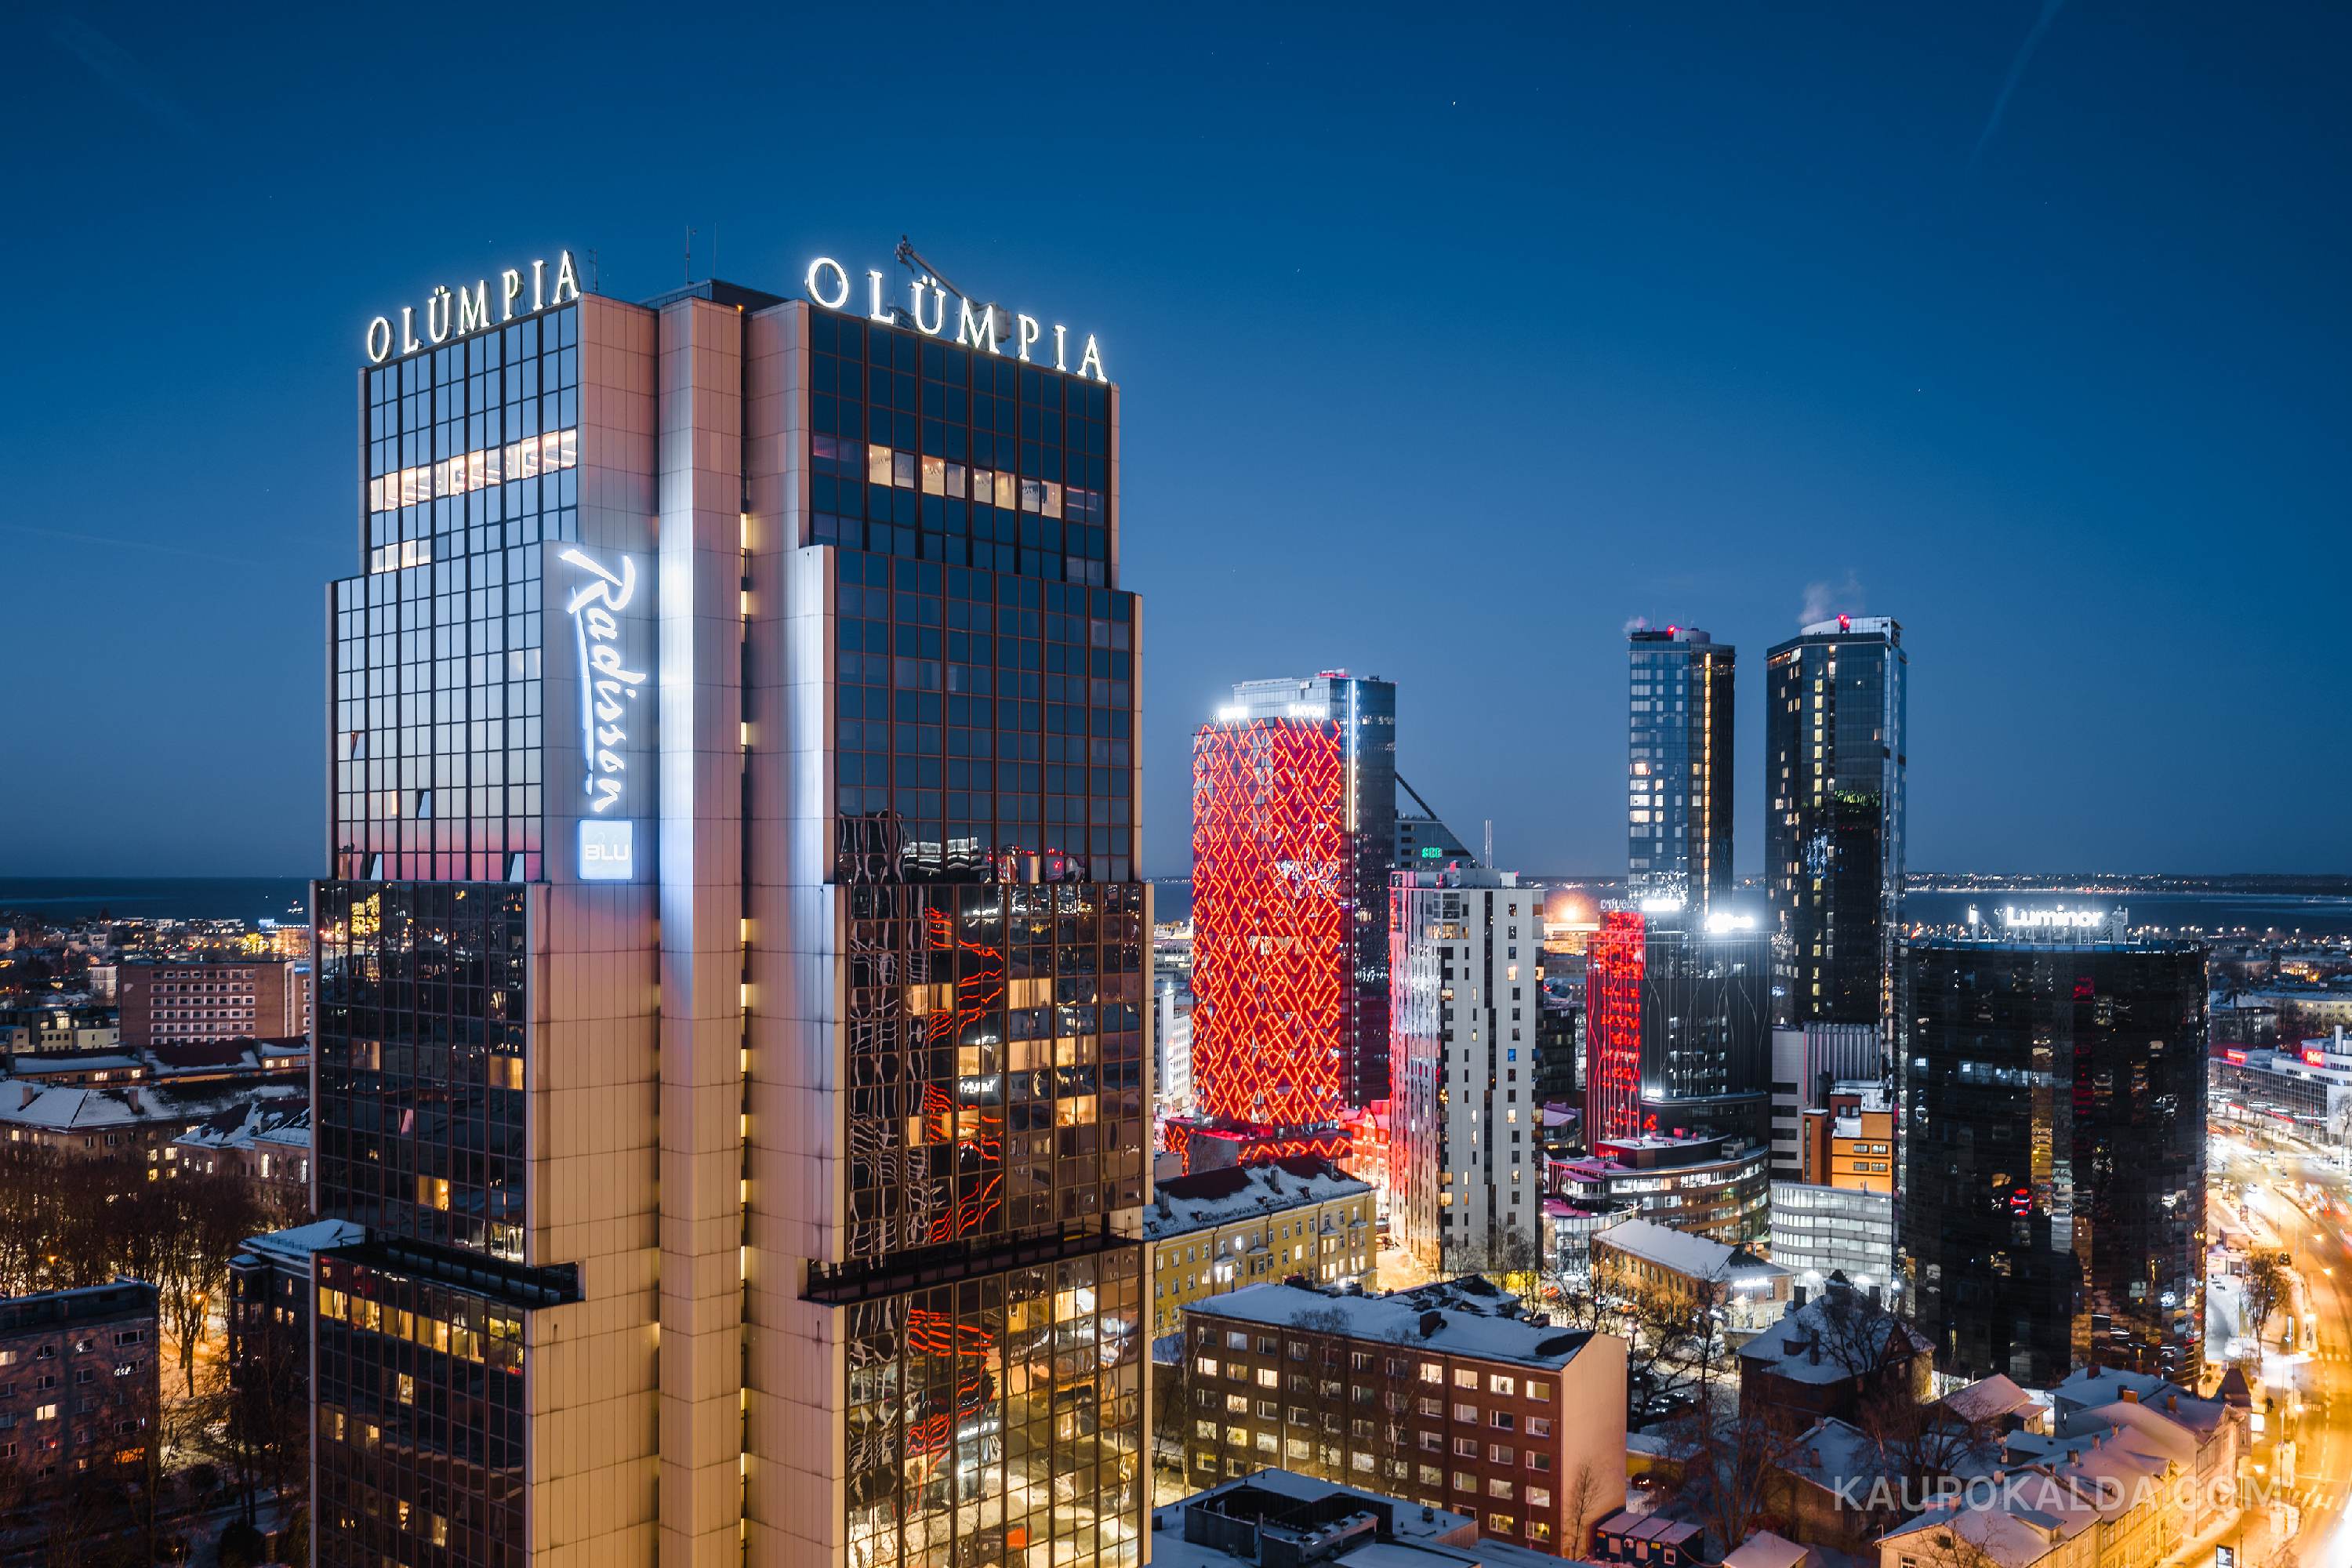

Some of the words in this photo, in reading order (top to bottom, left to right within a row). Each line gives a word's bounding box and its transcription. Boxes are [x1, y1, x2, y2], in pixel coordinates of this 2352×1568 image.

[367, 249, 580, 363] OLÜMPIA
[805, 256, 1108, 383] OLÜMPIA
[558, 549, 647, 812] Radisson
[584, 844, 630, 861] BLU
[2006, 904, 2103, 927] Luminor
